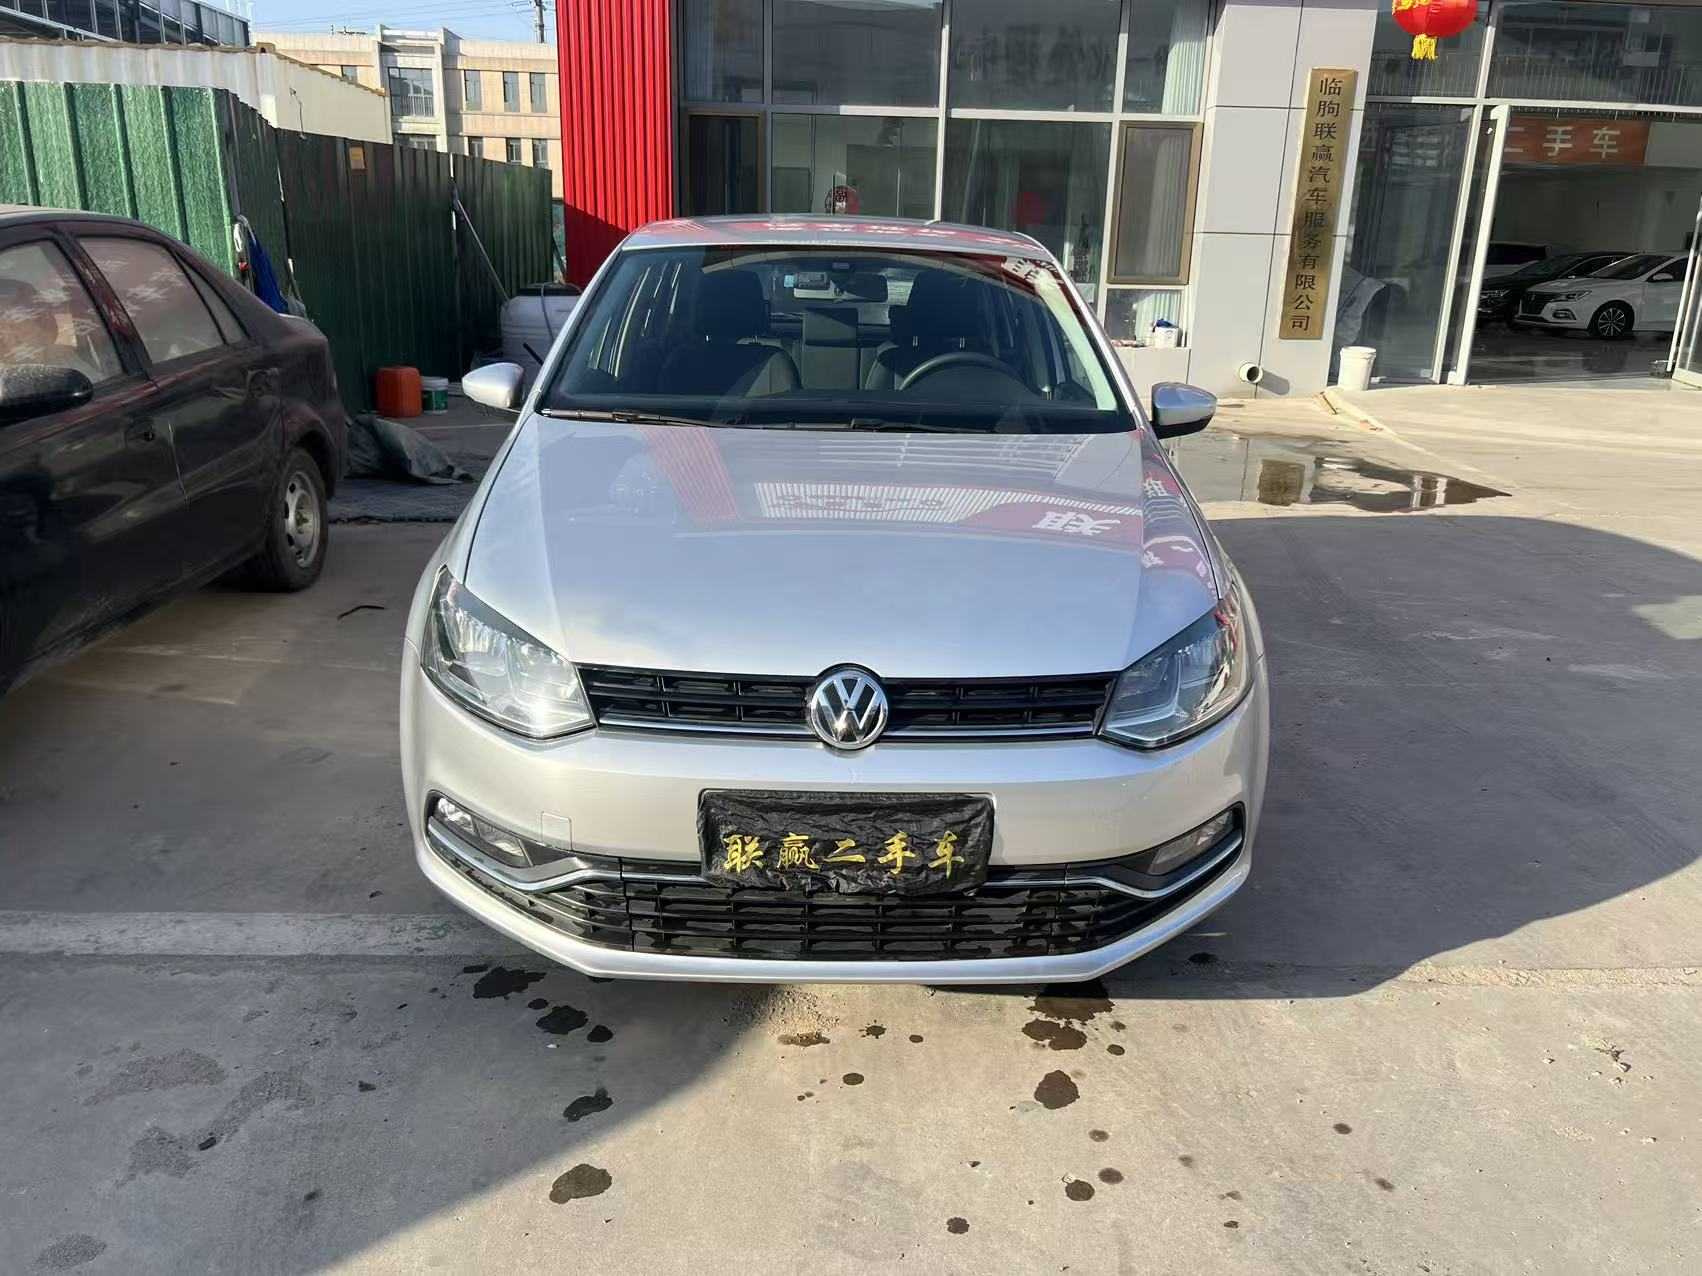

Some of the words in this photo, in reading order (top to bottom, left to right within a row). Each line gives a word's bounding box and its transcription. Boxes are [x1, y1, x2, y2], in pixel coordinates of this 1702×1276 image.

[1291, 77, 1344, 332] 临朐联赢汽车服务有限公司
[723, 832, 965, 879] 联赢二手车
